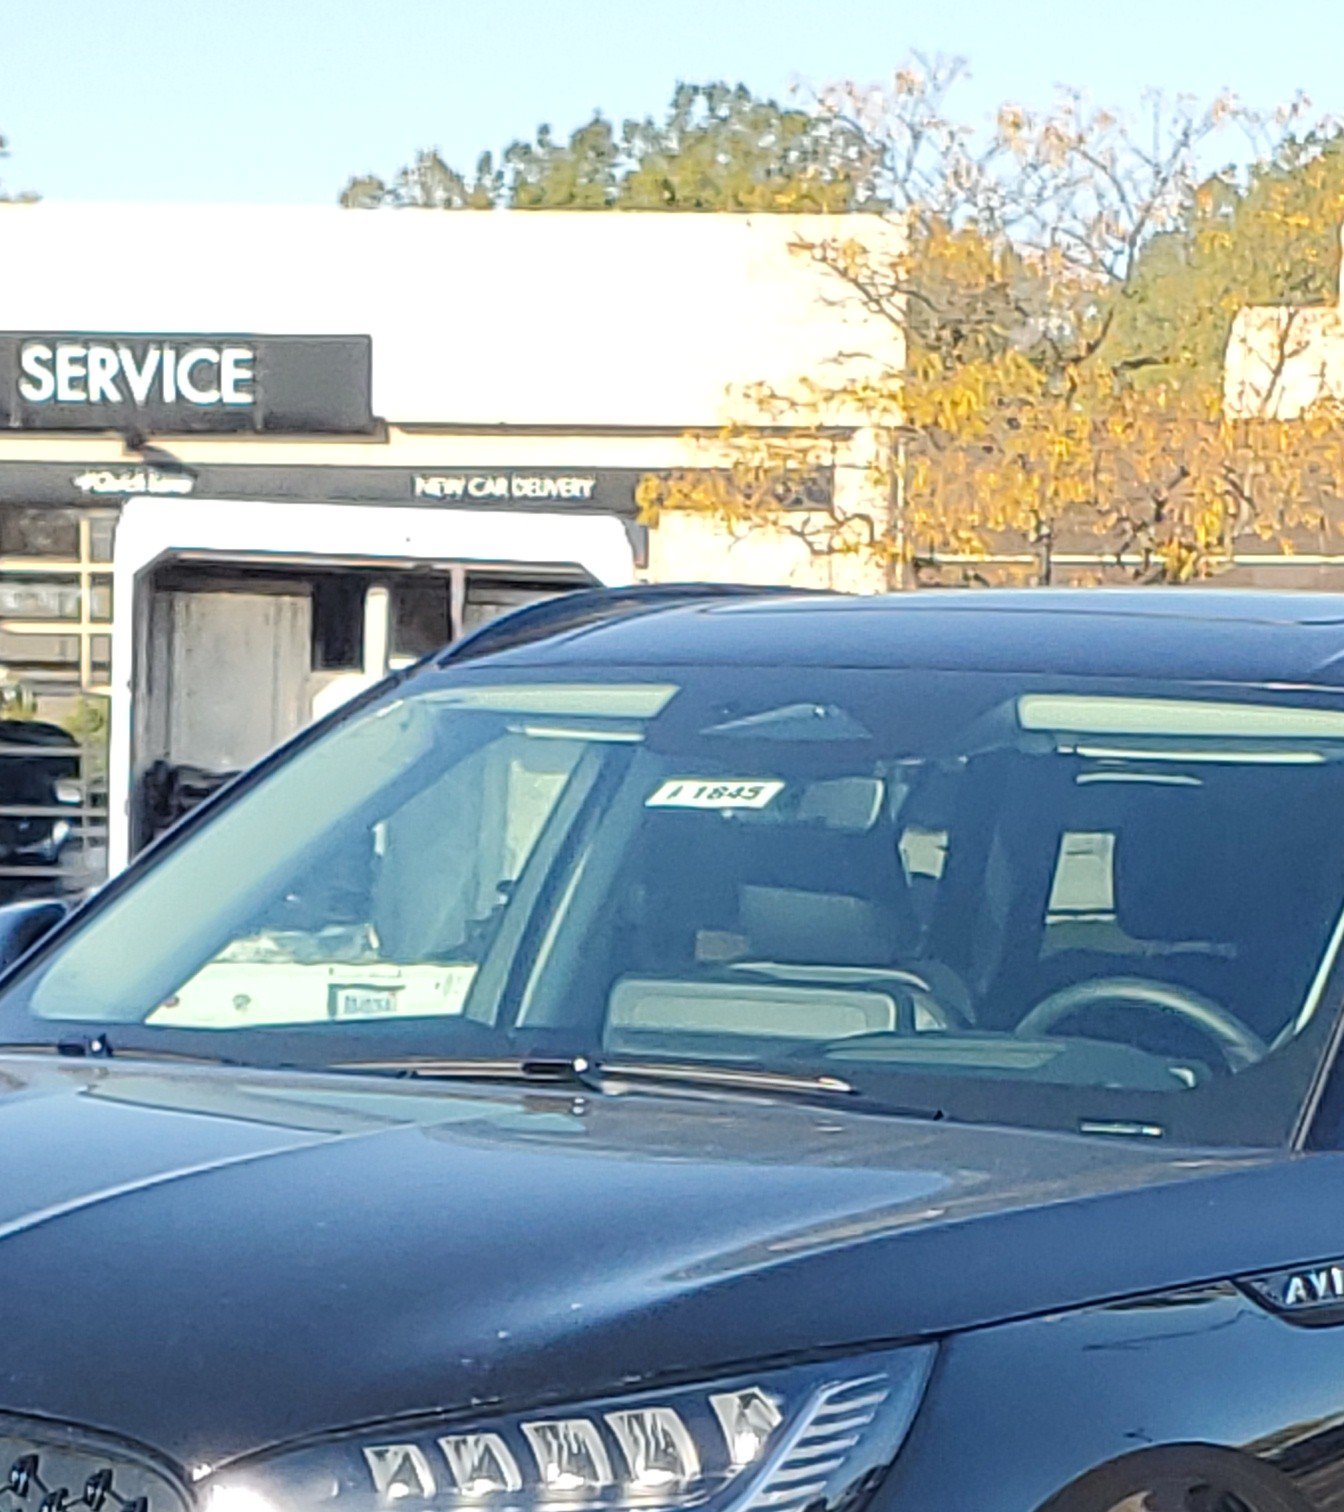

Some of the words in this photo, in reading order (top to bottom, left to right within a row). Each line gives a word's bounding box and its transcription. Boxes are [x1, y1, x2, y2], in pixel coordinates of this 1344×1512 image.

[18, 343, 255, 405] SERVICE
[414, 475, 466, 497] NEW
[467, 475, 511, 497] CAR
[511, 475, 597, 498] DELIVERY
